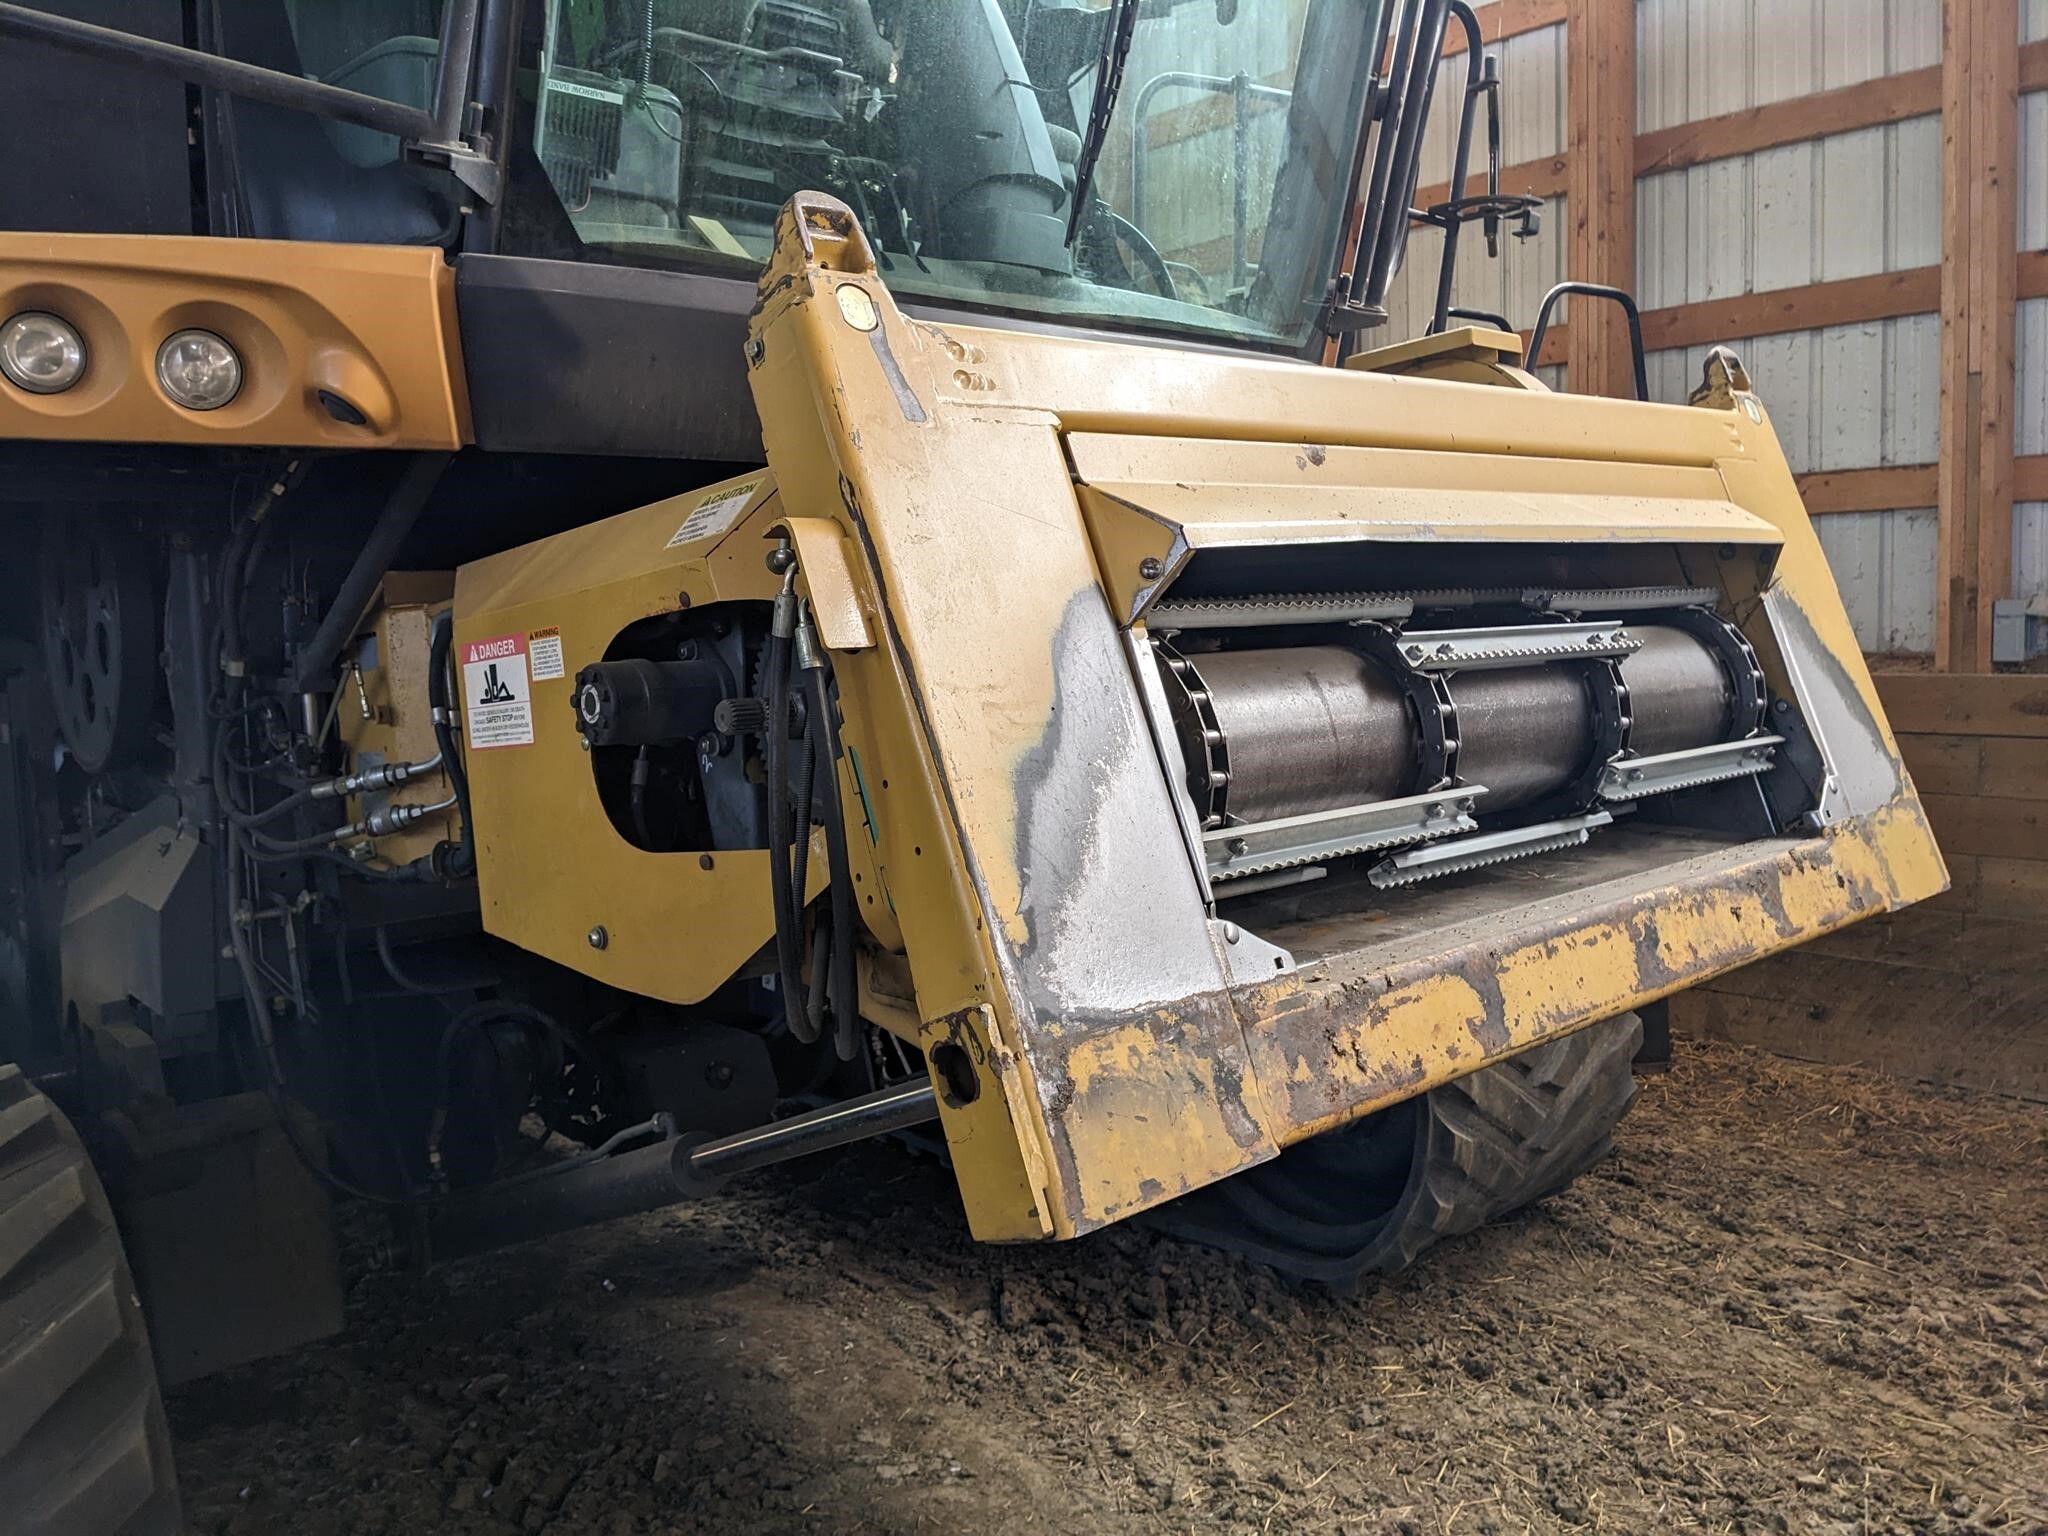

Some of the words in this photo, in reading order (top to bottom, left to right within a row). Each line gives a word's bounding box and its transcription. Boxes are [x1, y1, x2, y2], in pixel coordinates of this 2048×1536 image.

[572, 86, 605, 98] NARROW
[710, 483, 757, 504] CAUTION
[534, 627, 559, 638] WARNING
[479, 639, 516, 659] DANGER
[486, 715, 502, 724] SAFETY
[502, 713, 513, 723] STOP
